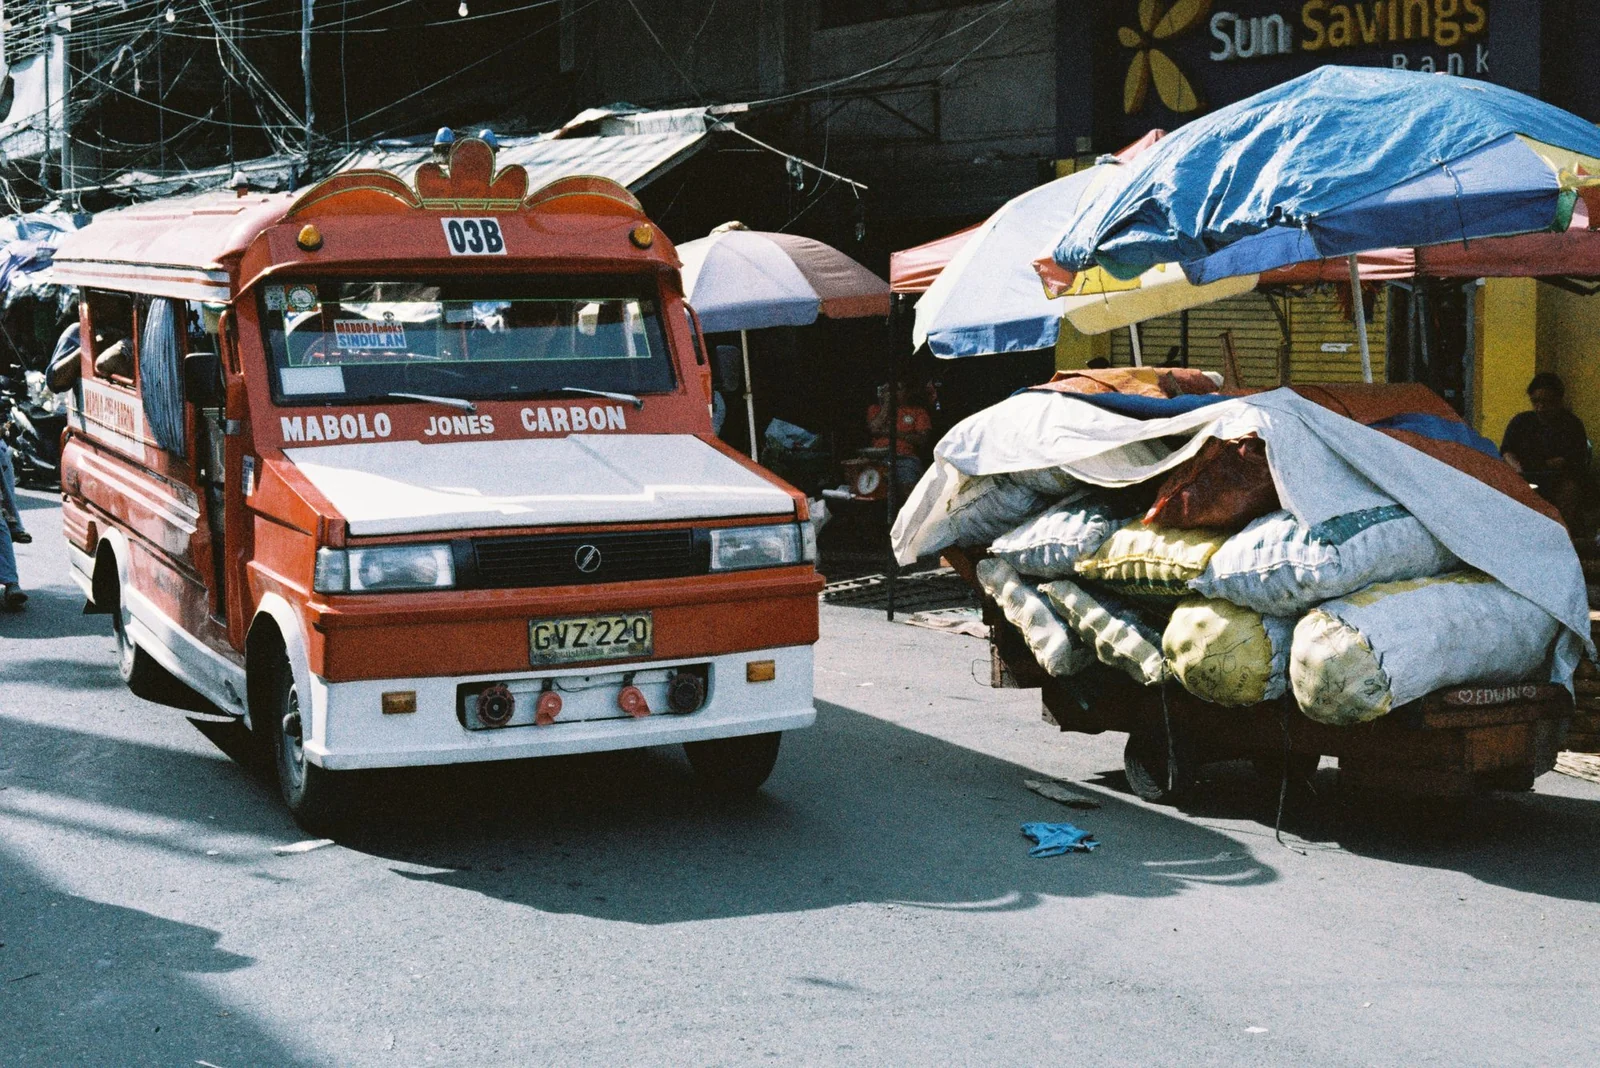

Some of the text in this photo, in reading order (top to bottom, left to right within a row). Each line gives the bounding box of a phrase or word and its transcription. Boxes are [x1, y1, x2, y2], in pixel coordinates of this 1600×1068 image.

[1209, 0, 1485, 61] Sun Savings
[448, 219, 503, 253] 03B
[338, 334, 405, 347] SINDULAN
[281, 406, 627, 441] MABOLO JONES CARBON
[1476, 687, 1520, 705] EDWIN
